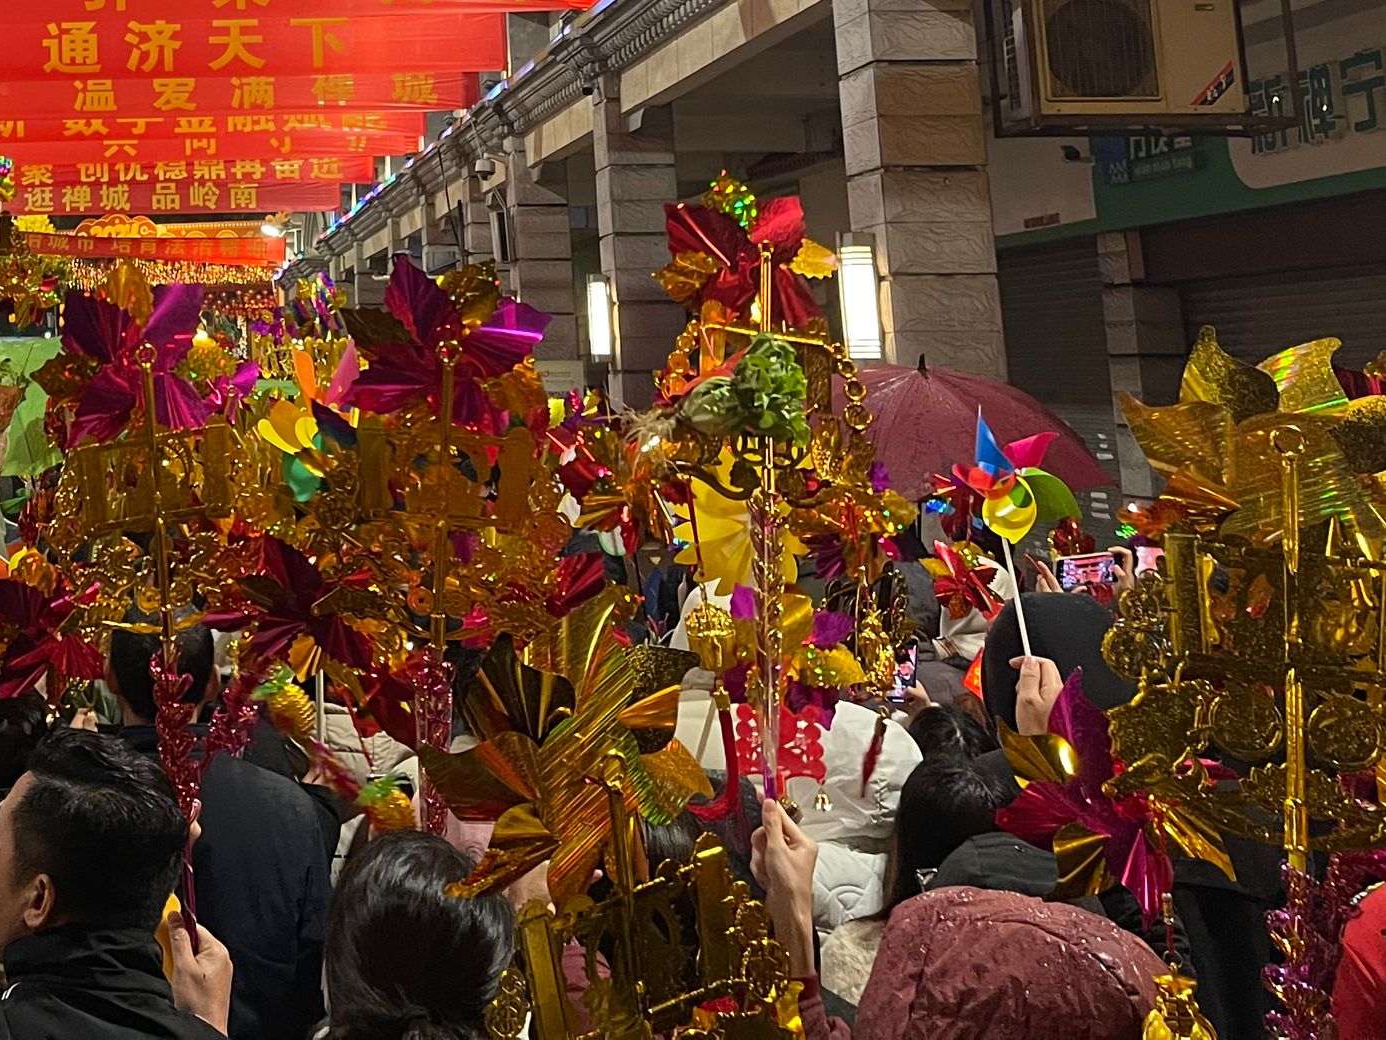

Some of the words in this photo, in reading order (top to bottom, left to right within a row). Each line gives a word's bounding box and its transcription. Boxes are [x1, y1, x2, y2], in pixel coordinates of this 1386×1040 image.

[42, 18, 349, 73] 通济天下
[24, 183, 132, 213] 逛禅城
[151, 181, 259, 210] 品岭南
